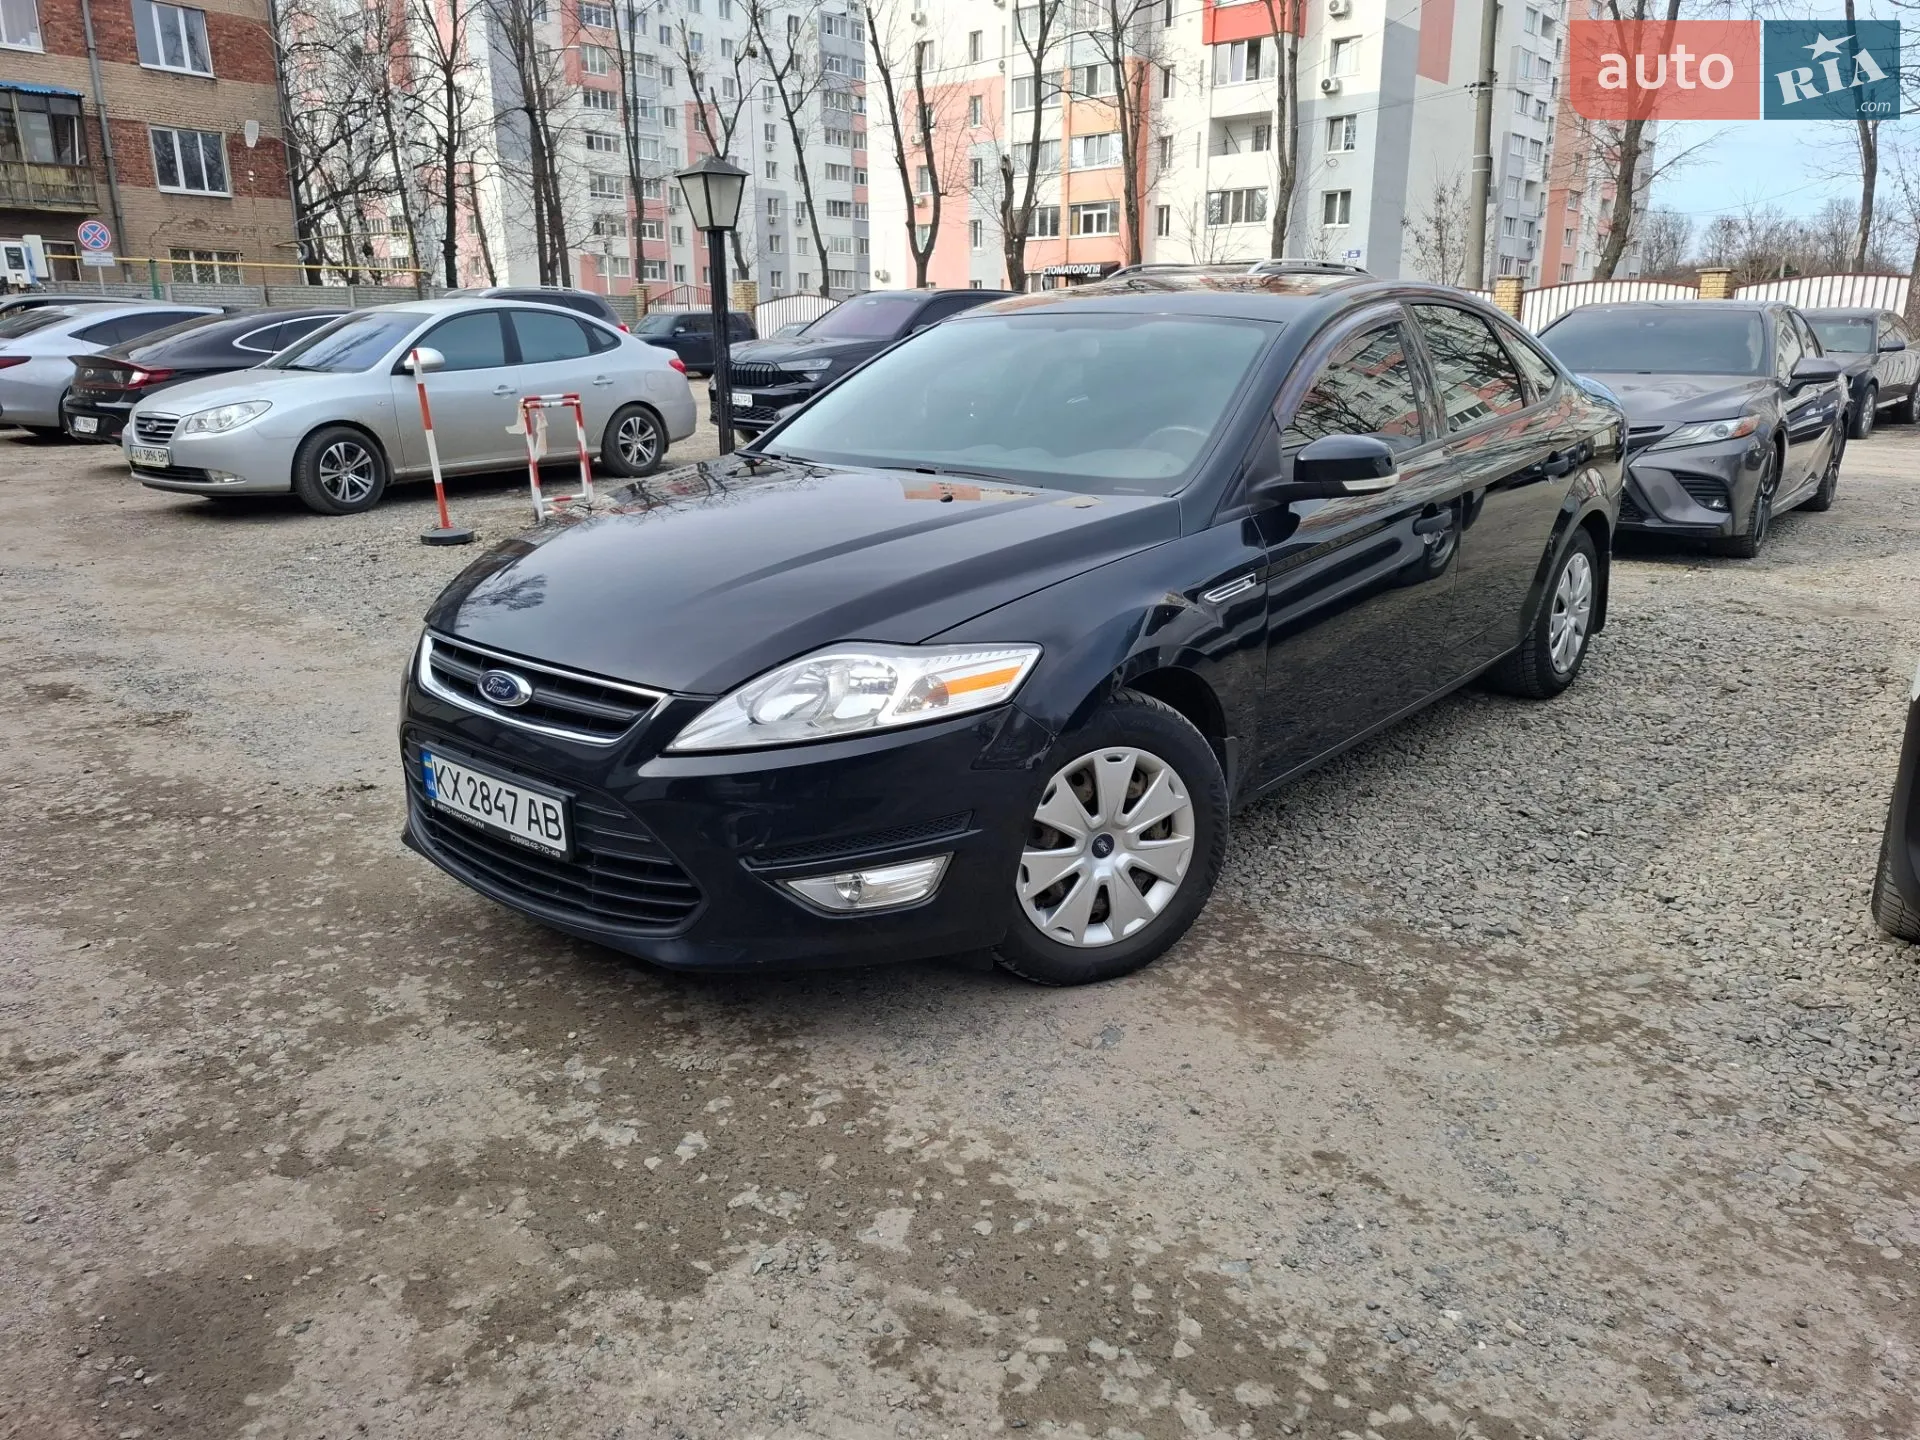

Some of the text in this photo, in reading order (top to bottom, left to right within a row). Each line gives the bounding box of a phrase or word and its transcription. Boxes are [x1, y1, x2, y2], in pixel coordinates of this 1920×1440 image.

[1043, 264, 1101, 275] СТОМАТОЛОГІЯ
[486, 676, 510, 697] Ford
[426, 778, 435, 791] UA
[433, 761, 562, 841] KX 2847 AB
